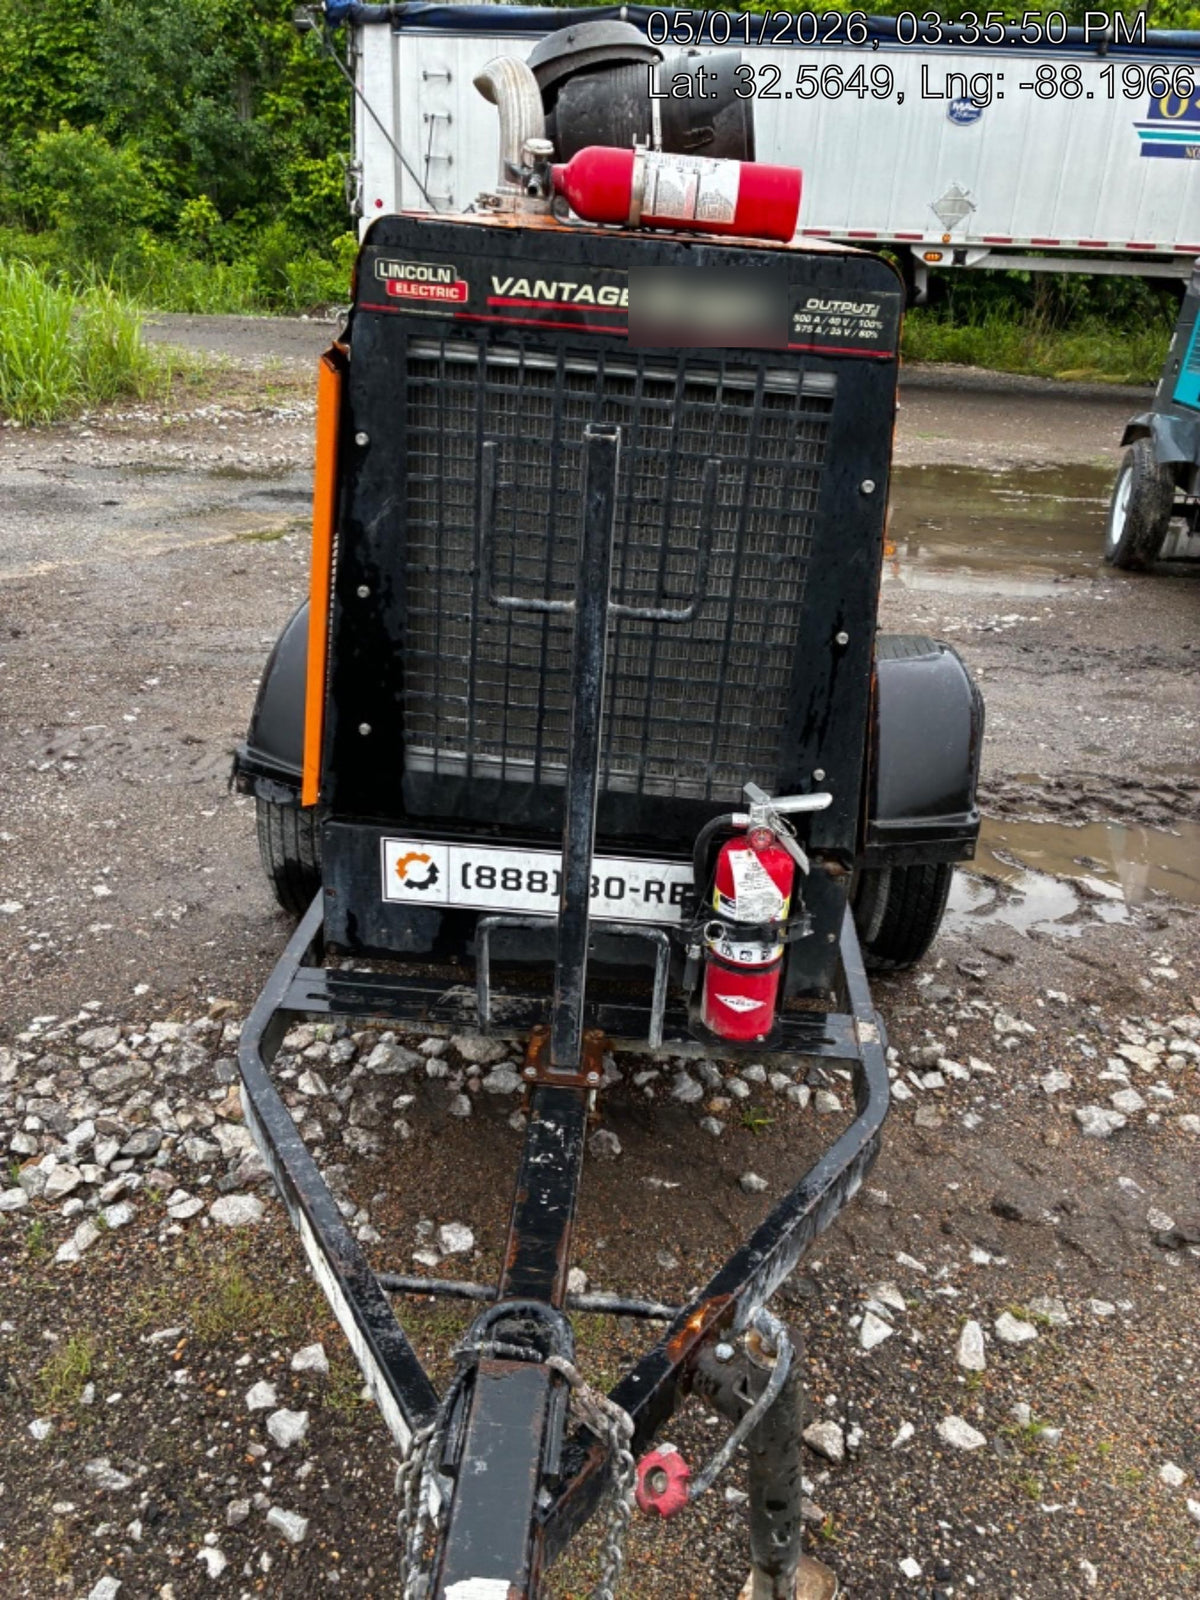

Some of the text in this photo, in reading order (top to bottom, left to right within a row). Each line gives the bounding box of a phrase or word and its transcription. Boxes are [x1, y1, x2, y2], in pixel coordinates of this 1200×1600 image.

[379, 262, 451, 283] LINCOLN
[395, 283, 460, 299] ELECTRIC
[806, 298, 876, 314] OUTPUT
[461, 861, 562, 896] (888)
